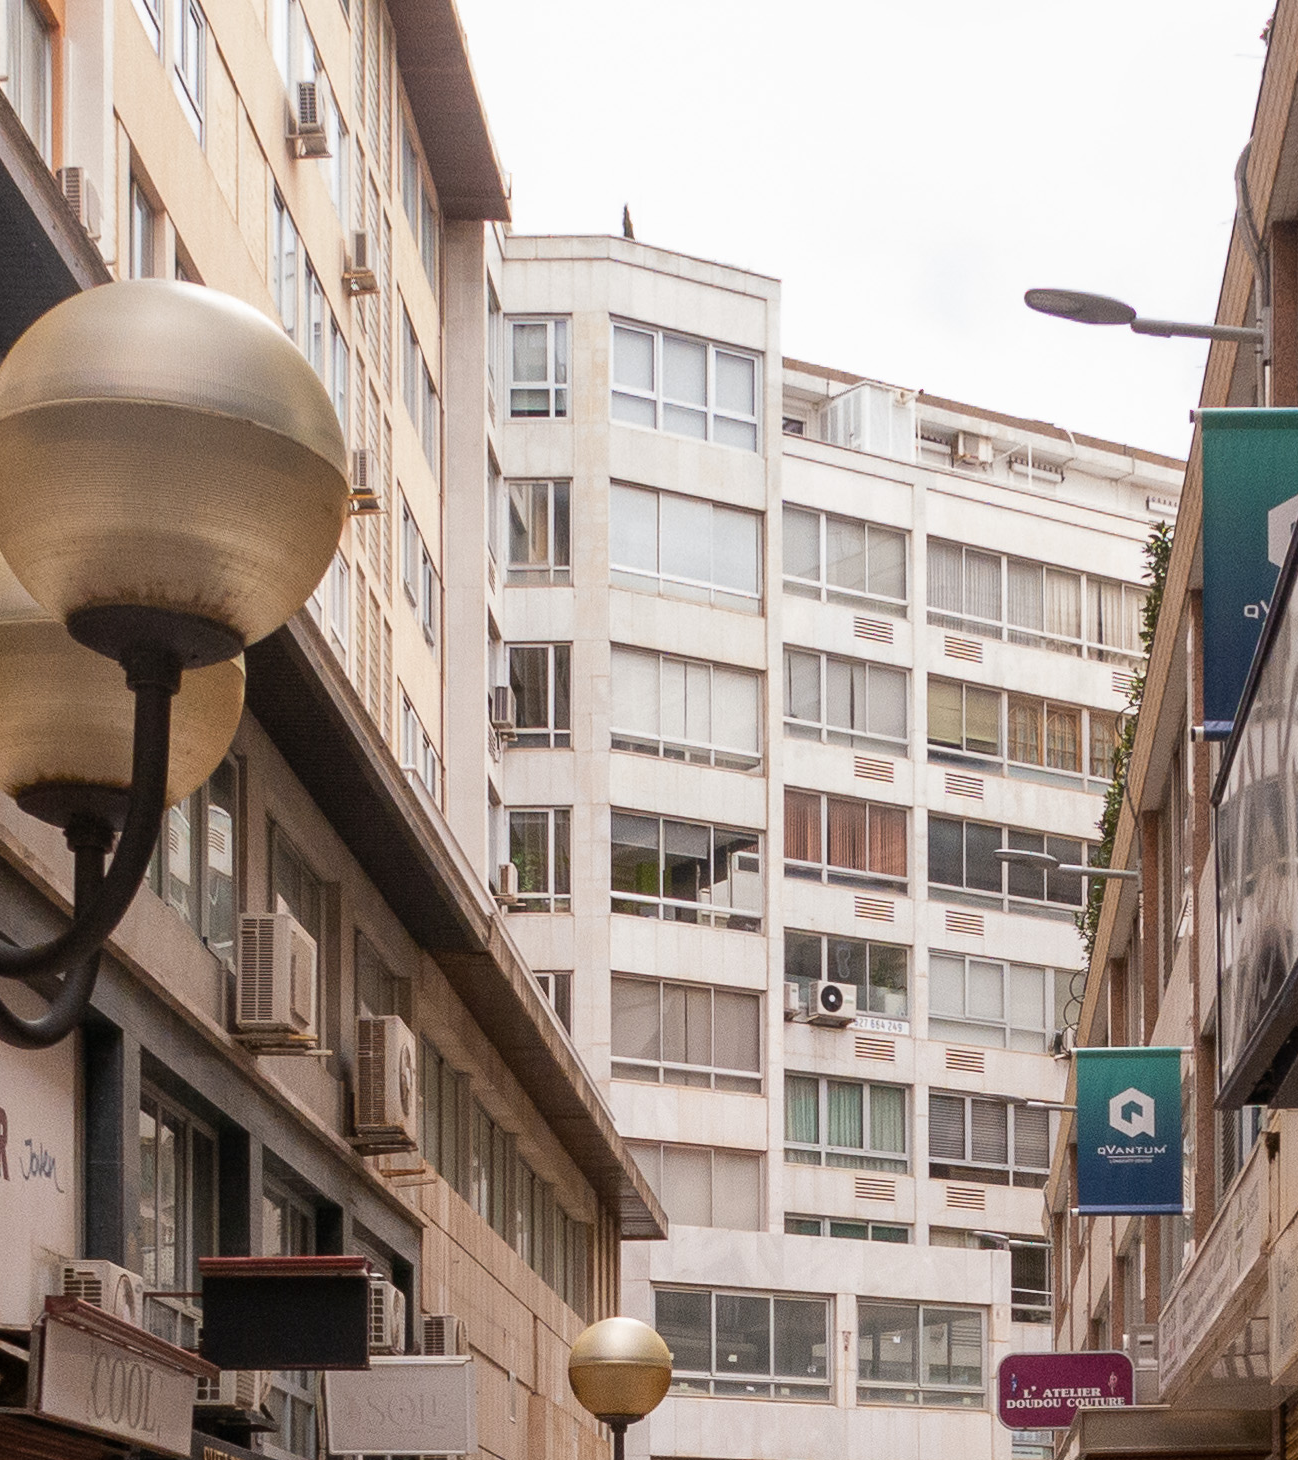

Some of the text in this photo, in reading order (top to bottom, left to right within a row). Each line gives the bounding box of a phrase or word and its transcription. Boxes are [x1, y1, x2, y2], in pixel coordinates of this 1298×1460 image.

[1042, 1387, 1102, 1398] ATELIER
[1006, 1396, 1126, 1410] DOUDOU COUTURE
